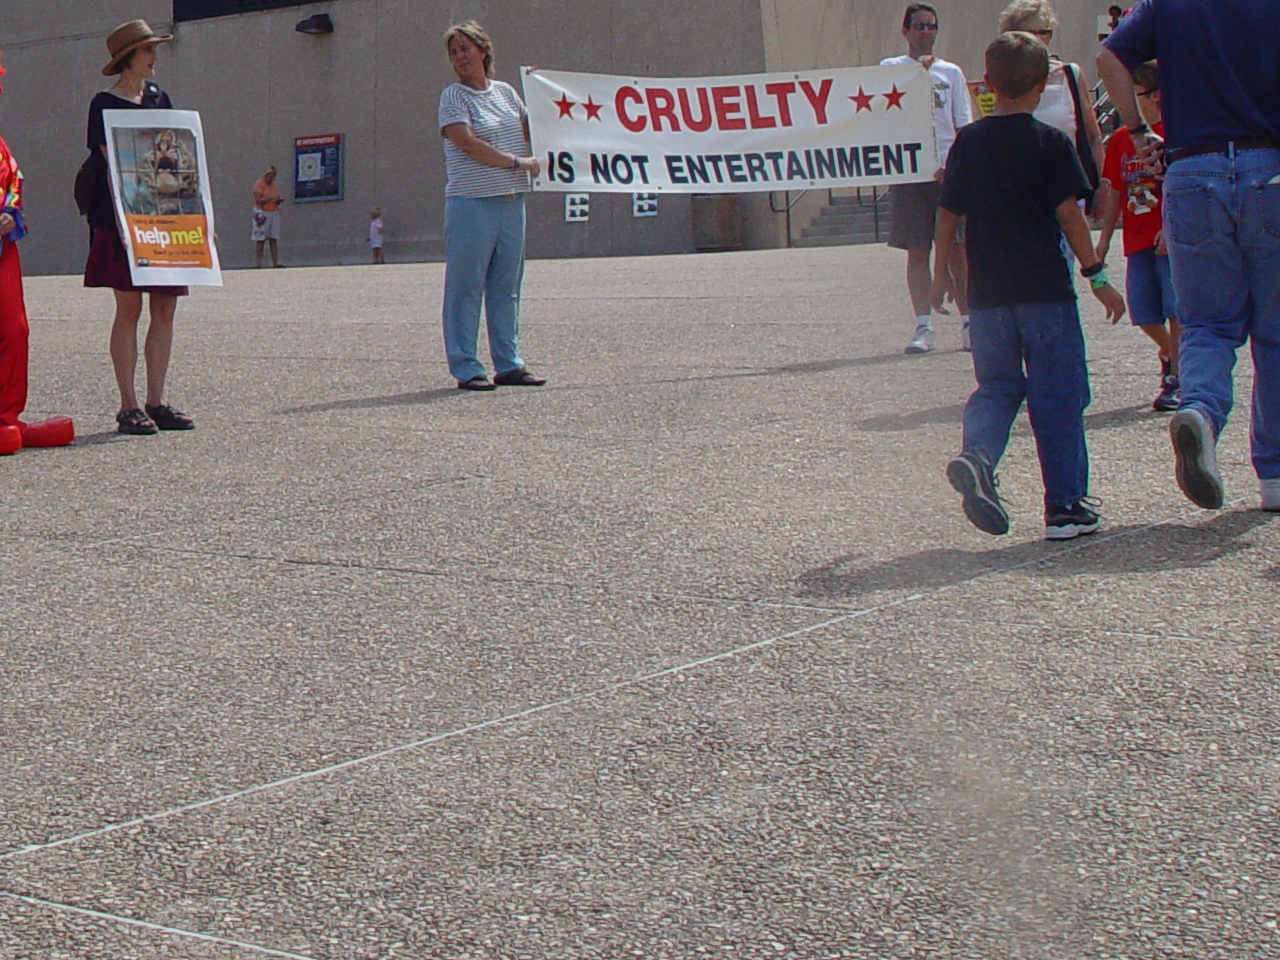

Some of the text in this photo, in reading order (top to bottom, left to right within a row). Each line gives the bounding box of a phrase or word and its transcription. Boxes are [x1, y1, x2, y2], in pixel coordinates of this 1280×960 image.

[615, 79, 833, 133] CRUELTY
[547, 143, 921, 186] IS NOT ENTERTAINMENT
[133, 225, 204, 248] help me!
